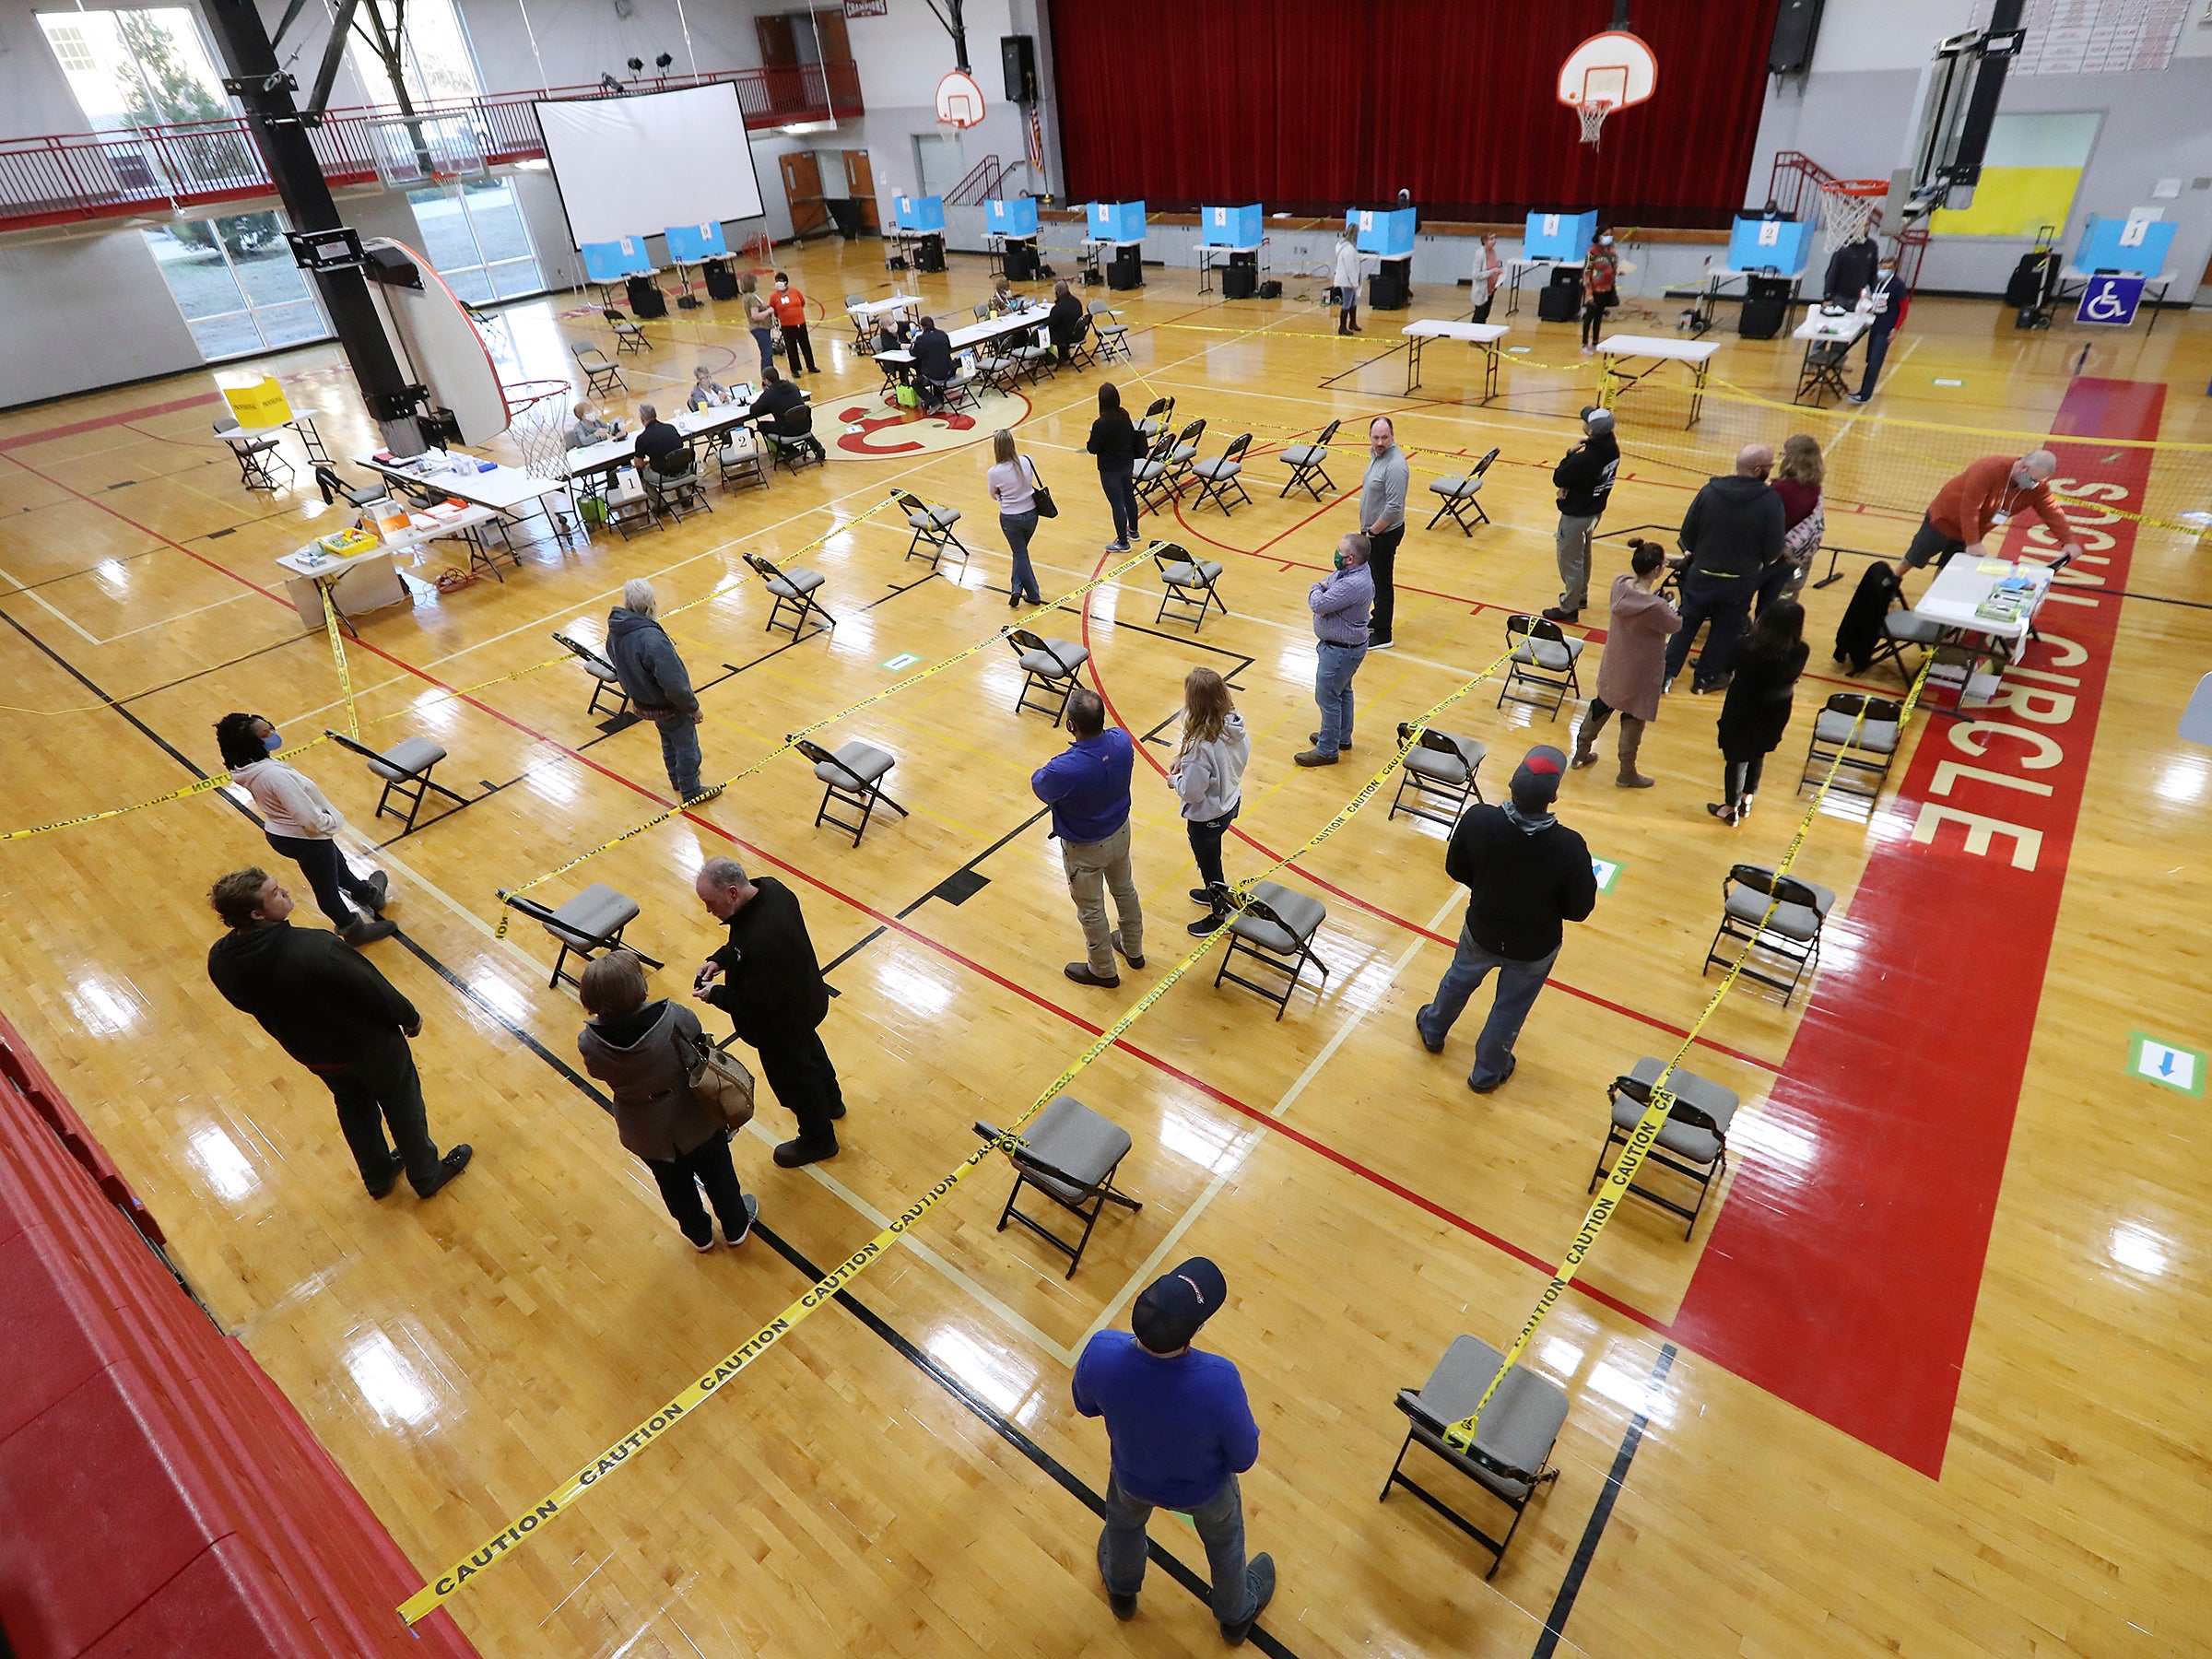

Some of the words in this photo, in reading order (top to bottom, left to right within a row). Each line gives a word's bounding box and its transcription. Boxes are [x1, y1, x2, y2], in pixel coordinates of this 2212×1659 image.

[1218, 212, 1224, 220] 5
[1548, 220, 1555, 229] 3
[1765, 229, 1774, 240] 2
[2131, 228, 2138, 240] 1
[966, 360, 973, 371] 3
[737, 436, 747, 448] 2
[628, 477, 636, 489] 1
[836, 697, 878, 718] CAUTION
[885, 674, 925, 694] CAUTION
[931, 652, 970, 672] CAUTION
[974, 630, 1009, 651] CAUTION
[1075, 578, 1105, 595] CAUTION
[1108, 560, 1136, 578] CAUTION
[1139, 542, 1166, 559] CAUTION
[1433, 694, 1462, 713] CAUTION
[1463, 673, 1489, 692] CAUTION
[1911, 632, 2089, 872] CIRCLE
[1310, 816, 1347, 846] CAUTION
[1347, 779, 1382, 813] CAUTION
[1382, 740, 1415, 775] CAUTION
[618, 812, 670, 841] CAUTION
[1513, 1277, 1567, 1347] AUTION
[1565, 1197, 1616, 1265] CAUTION
[1611, 1121, 1657, 1186] CAUTION
[434, 1499, 559, 1596] CAUTION
[579, 1402, 684, 1486] CAUTION
[699, 1318, 790, 1392] CAUTION
[801, 1242, 880, 1309] CAUTION
[888, 1173, 959, 1234] CAUTION
